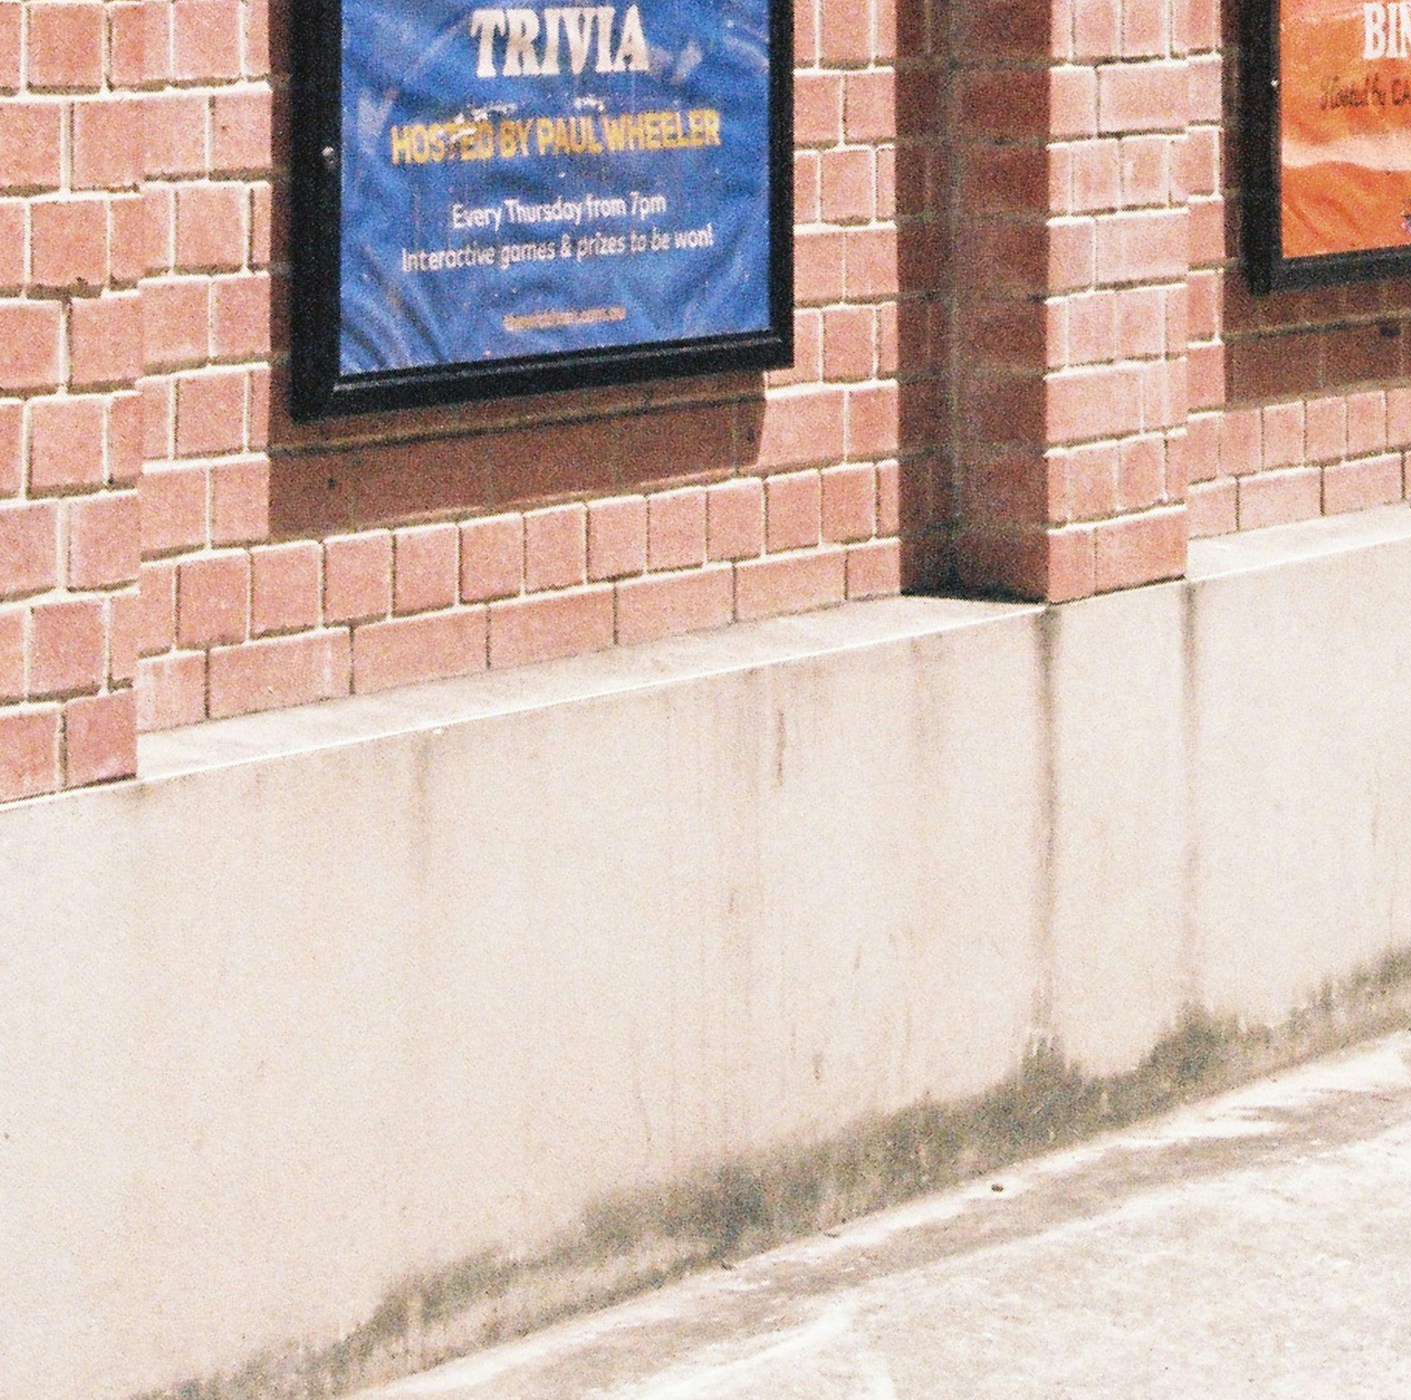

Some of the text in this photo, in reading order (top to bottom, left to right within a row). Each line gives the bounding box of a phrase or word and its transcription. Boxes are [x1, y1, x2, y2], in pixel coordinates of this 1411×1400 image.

[471, 4, 650, 78] TRIVIA
[390, 107, 722, 166] HOSTED BY PAUL WHEELER
[452, 190, 667, 231] Every Thursday from 7pm
[401, 221, 716, 273] Interactive games & prizes to be won!
